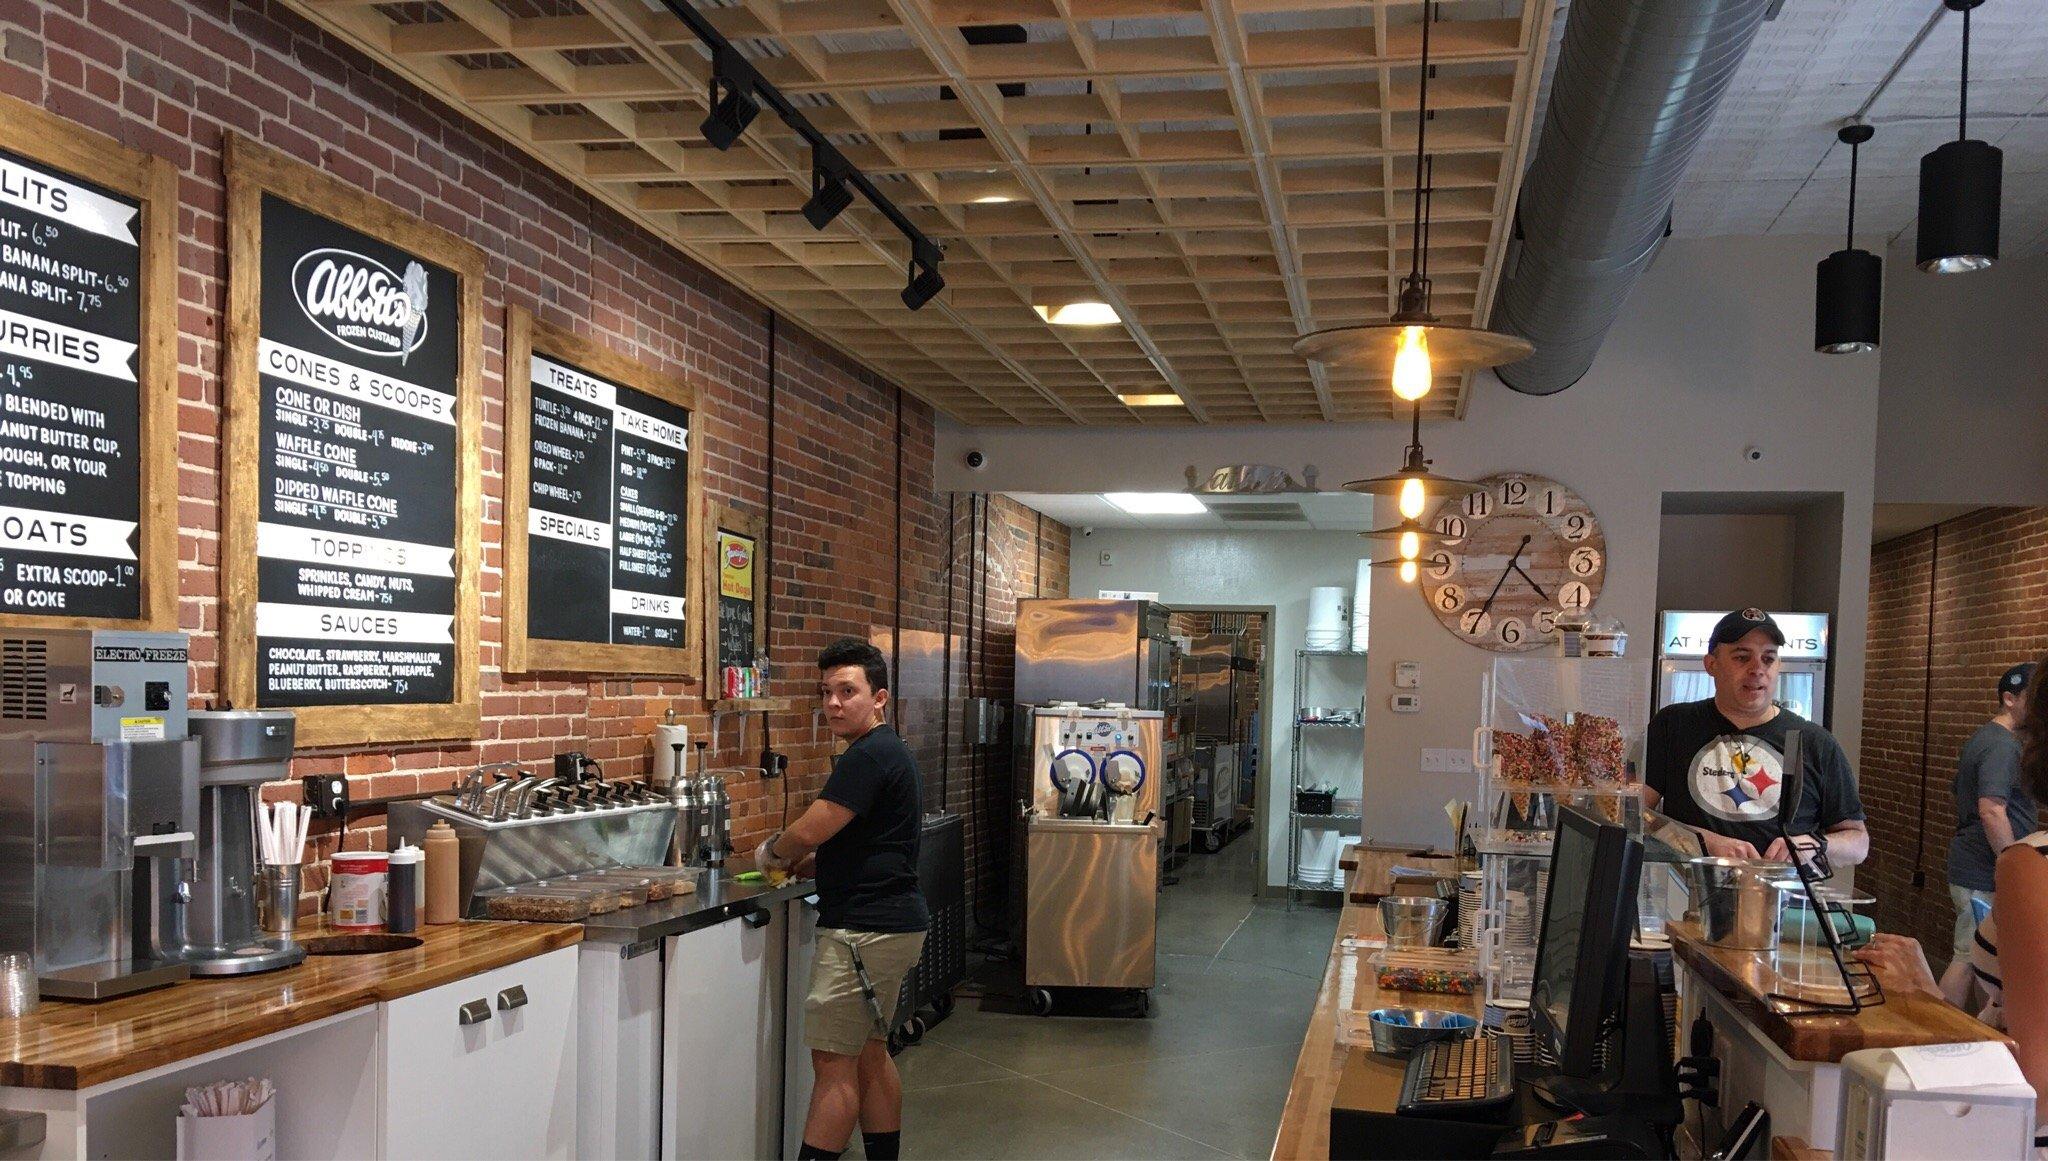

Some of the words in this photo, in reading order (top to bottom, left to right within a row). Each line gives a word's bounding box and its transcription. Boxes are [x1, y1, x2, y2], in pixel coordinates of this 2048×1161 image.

[2, 244, 60, 278] BANANA
[337, 325, 367, 338] FROZEN
[368, 327, 401, 348] CUSTARD
[269, 349, 340, 386] CONES
[349, 373, 360, 392] &
[370, 380, 442, 414] SCOOPS
[549, 368, 597, 399] TREATS
[5, 393, 69, 421] BLENDED
[71, 407, 105, 429] WITH
[275, 386, 311, 411] CONE
[313, 396, 331, 415] OR
[333, 401, 361, 422] DISH
[534, 413, 559, 432] FROZEN
[621, 411, 648, 433] TAKE
[653, 423, 681, 444] HOME
[41, 427, 89, 450] BUTTER
[93, 440, 121, 458] CUP,
[276, 432, 322, 456] WAFFLE
[324, 443, 357, 464] CONE
[534, 440, 552, 455] OREO
[0, 446, 47, 469] OUGH,
[51, 454, 70, 472] OR
[73, 457, 107, 478] YOUR
[5, 471, 66, 495] TOPPING
[533, 481, 549, 495] CHIP
[620, 485, 638, 500] CAKES
[1502, 481, 1527, 505] 12
[276, 477, 320, 500] DIPPED
[321, 485, 365, 509] WAFFLE
[366, 494, 398, 514] CONE
[1467, 491, 1488, 516] 11
[1544, 490, 1553, 514] 1
[540, 516, 600, 541] SPECIALS
[1442, 517, 1465, 540] 10
[1567, 515, 1585, 539] 2
[311, 537, 406, 566] TOPPS
[1575, 550, 1594, 574] 3
[17, 563, 60, 584] EXTRA
[1431, 552, 1450, 576] 9
[297, 583, 341, 599] WHIPPED
[298, 567, 352, 588] SPRINKLES,
[354, 573, 387, 590] CANDY,
[388, 576, 414, 593] NUTS,
[4, 588, 23, 605] OR
[27, 589, 65, 608] COKE
[631, 596, 669, 614] DRINKS
[1441, 586, 1459, 610] 8
[1564, 585, 1584, 609] 4
[320, 613, 398, 635] SAUCES
[1467, 611, 1484, 634] 7
[1501, 620, 1520, 644] 6
[1539, 611, 1556, 634] 5
[1669, 636, 1691, 648] AT
[145, 649, 186, 661] FREEZE
[268, 647, 324, 662] CHOCOLATE,
[326, 649, 381, 664] STRAWBERRY,
[382, 651, 442, 666] MARSHMALLOW,
[268, 663, 304, 676] PEANUT
[306, 664, 342, 676] BUTTER,
[343, 664, 391, 677] RASPBERRY,
[392, 665, 435, 678] PINEAPPLE,
[268, 677, 322, 692] BLUEBERRY,
[1702, 766, 1735, 779] Steelers
